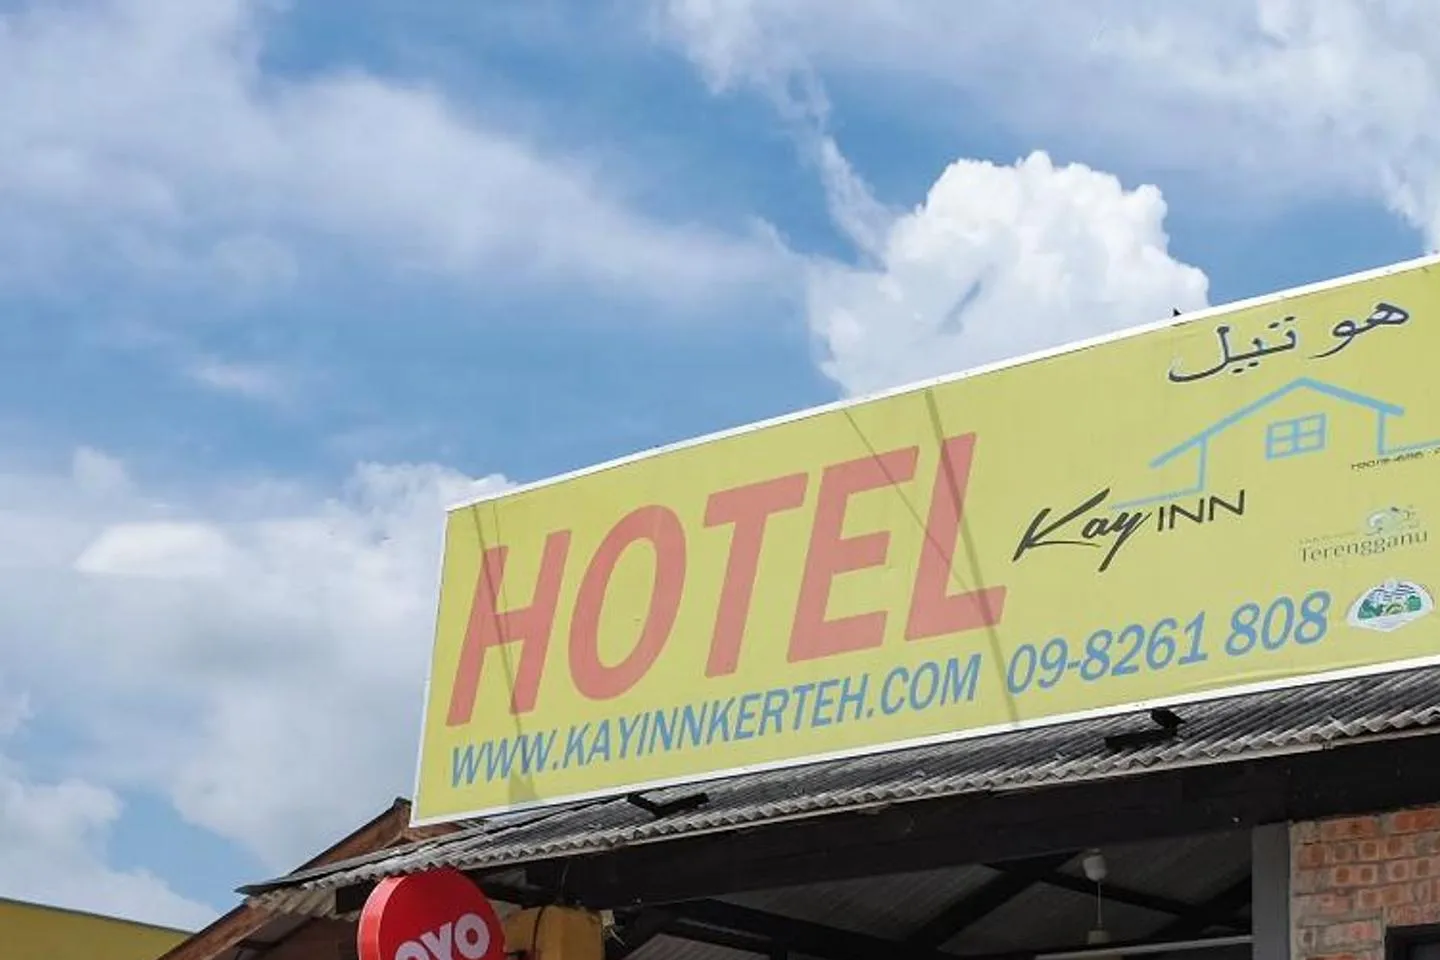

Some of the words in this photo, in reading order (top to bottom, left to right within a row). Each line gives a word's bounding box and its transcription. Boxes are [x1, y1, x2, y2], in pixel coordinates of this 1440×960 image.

[445, 432, 1007, 728] HOTEL
[1011, 487, 1153, 573] Kay
[1156, 489, 1247, 533] INN
[1300, 530, 1429, 563] Terengganu
[449, 653, 983, 789] WWW.KAYINNKERTEH.COM
[1006, 611, 1209, 695] 09-8261
[1224, 590, 1332, 657] 808
